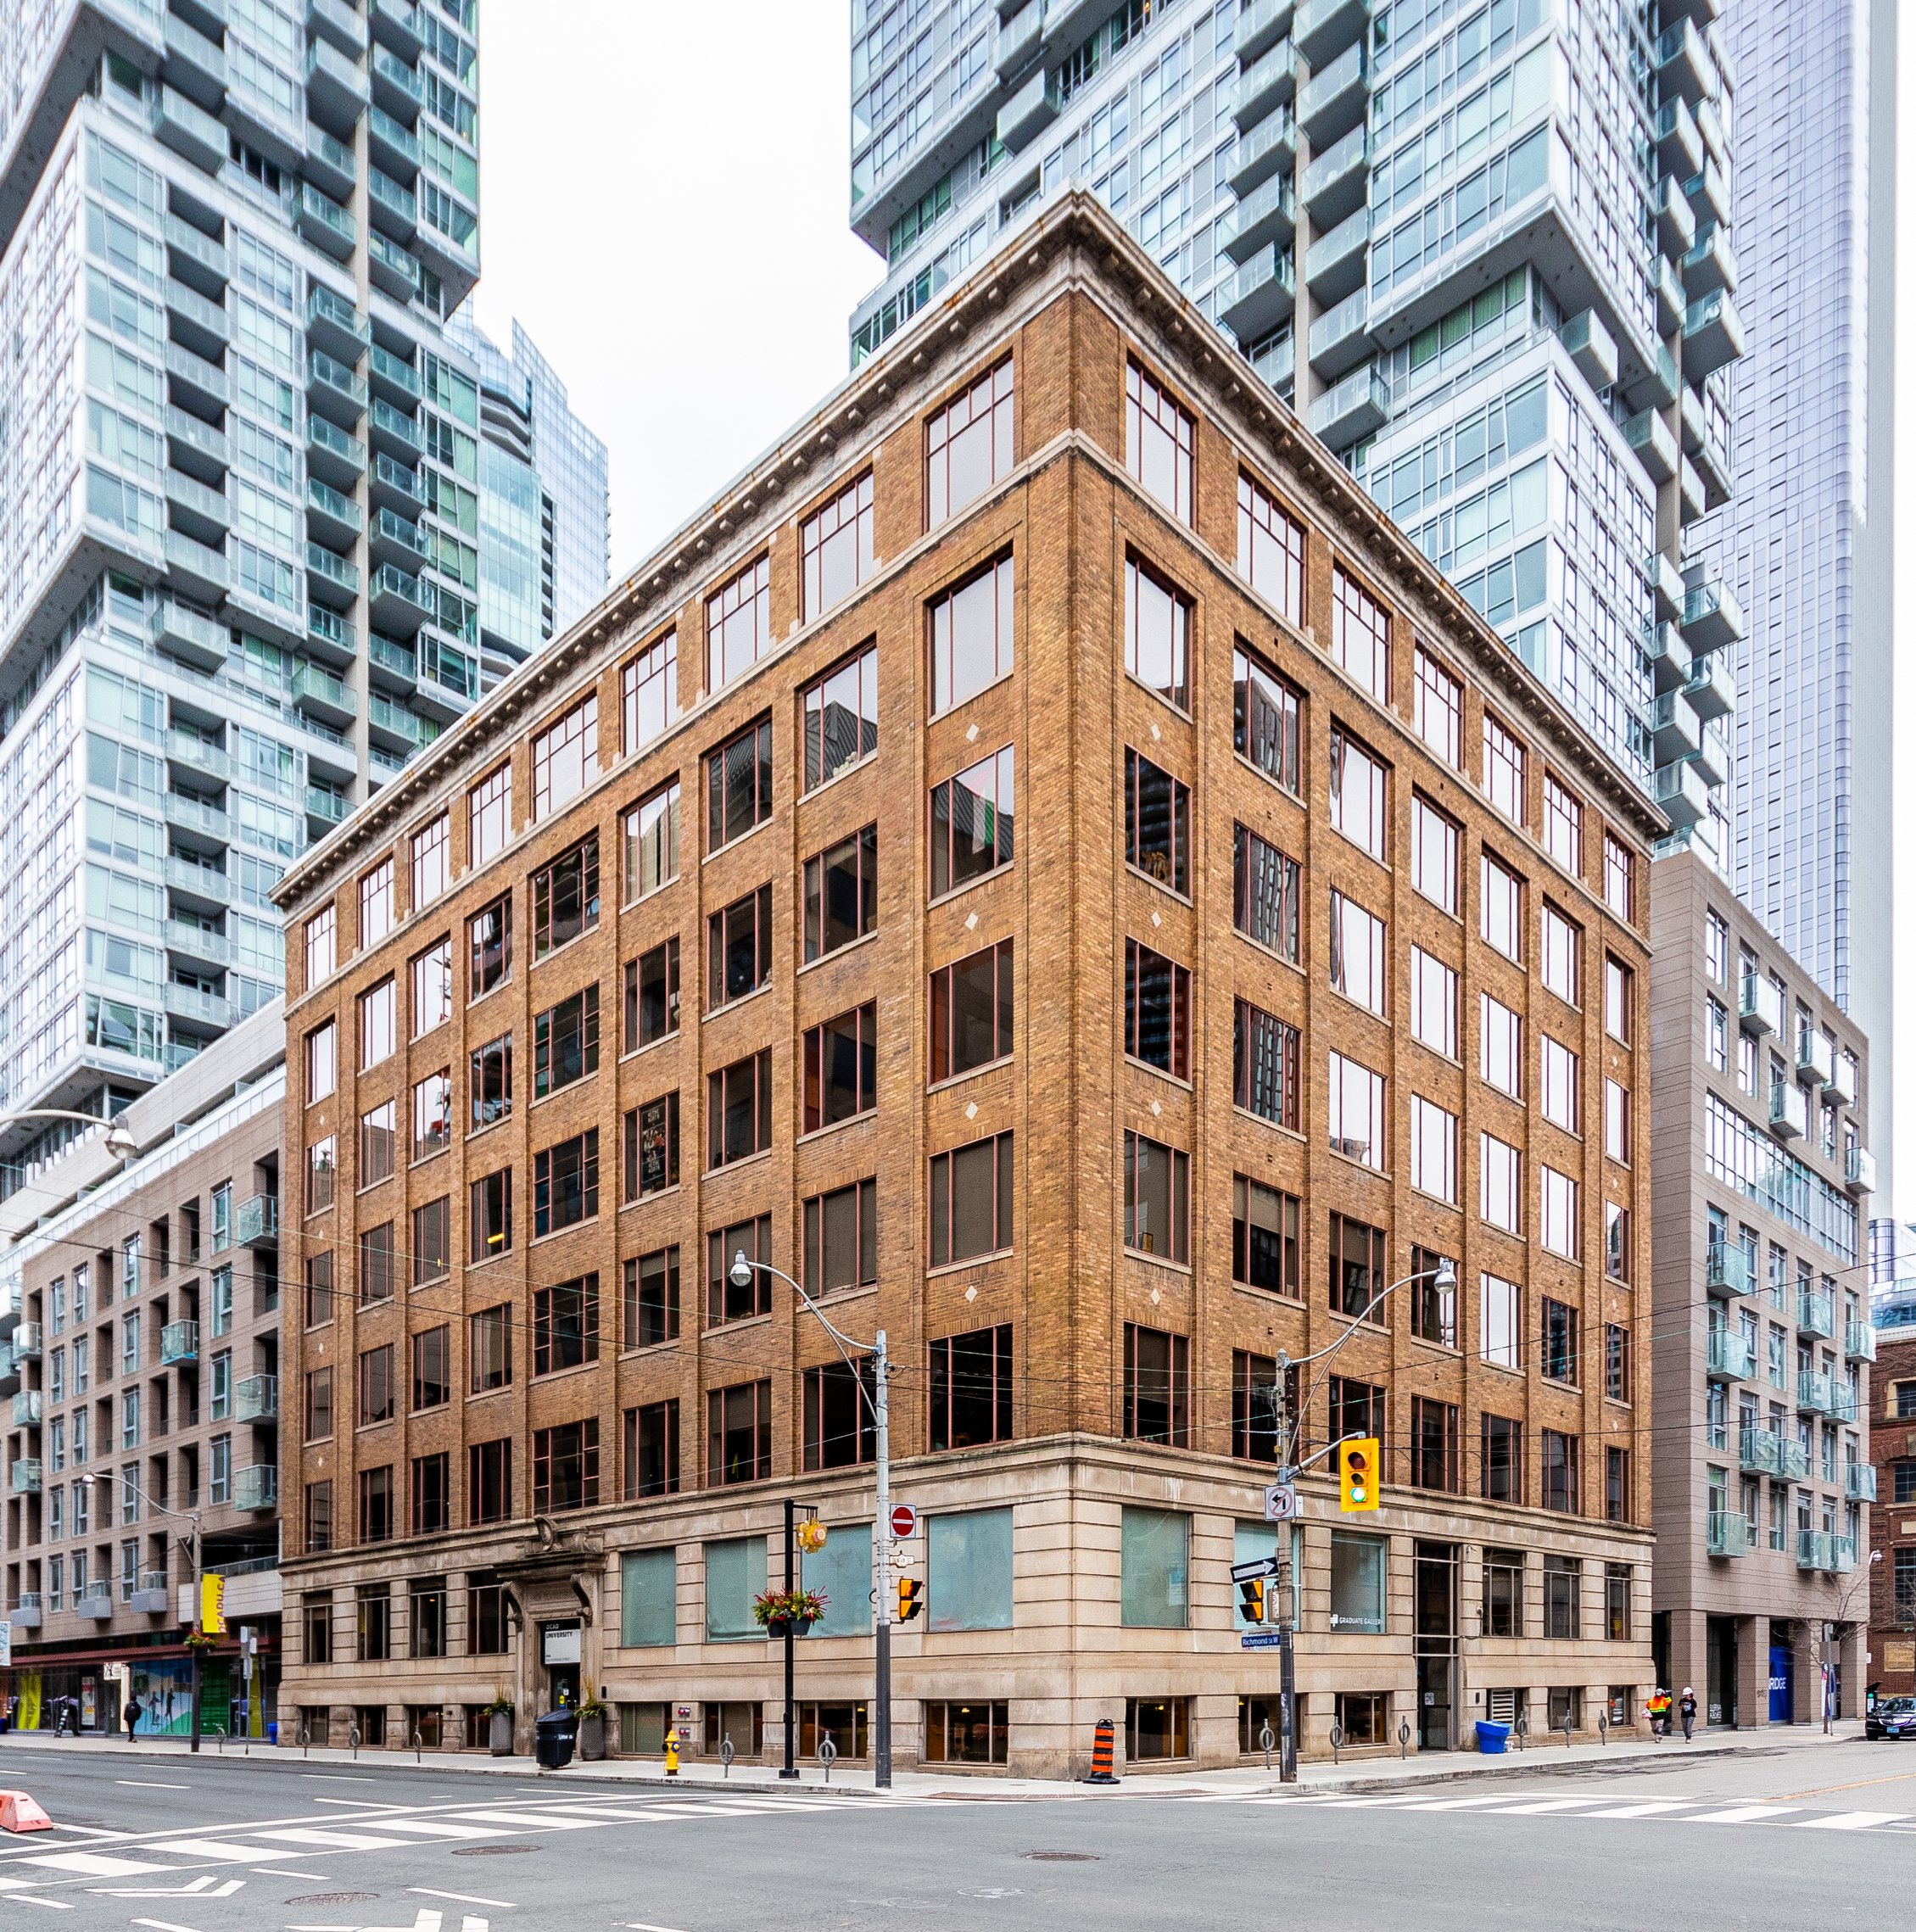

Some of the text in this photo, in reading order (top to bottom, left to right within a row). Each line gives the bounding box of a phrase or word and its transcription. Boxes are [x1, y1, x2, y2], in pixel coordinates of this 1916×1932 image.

[1338, 1617, 1364, 1625] GRADUATE
[1364, 1617, 1384, 1626] GALLERY
[1242, 1637, 1268, 1646] Richmond
[1768, 1677, 1787, 1690] RIDGE
